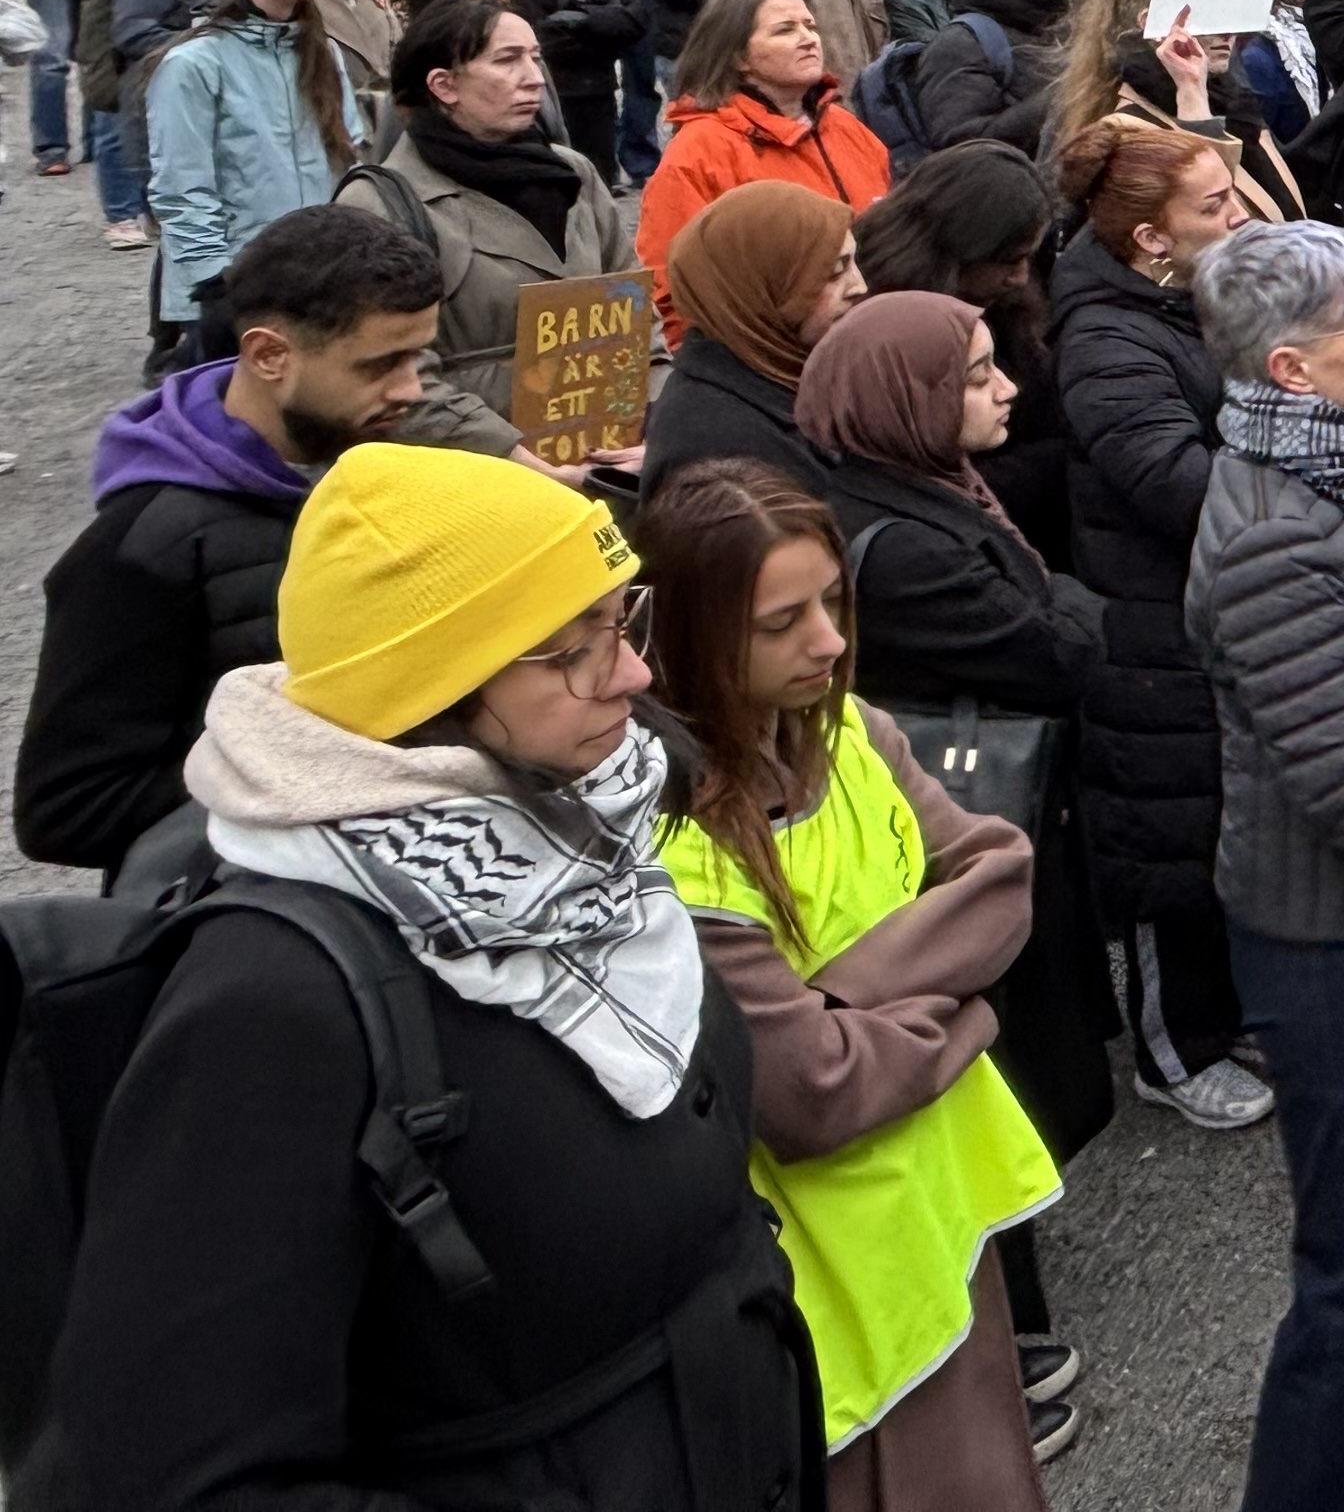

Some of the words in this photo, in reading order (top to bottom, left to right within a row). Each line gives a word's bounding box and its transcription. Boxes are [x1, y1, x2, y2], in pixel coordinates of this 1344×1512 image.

[537, 297, 632, 354] BARN
[563, 353, 604, 384] ÄR
[545, 387, 596, 421] ETT
